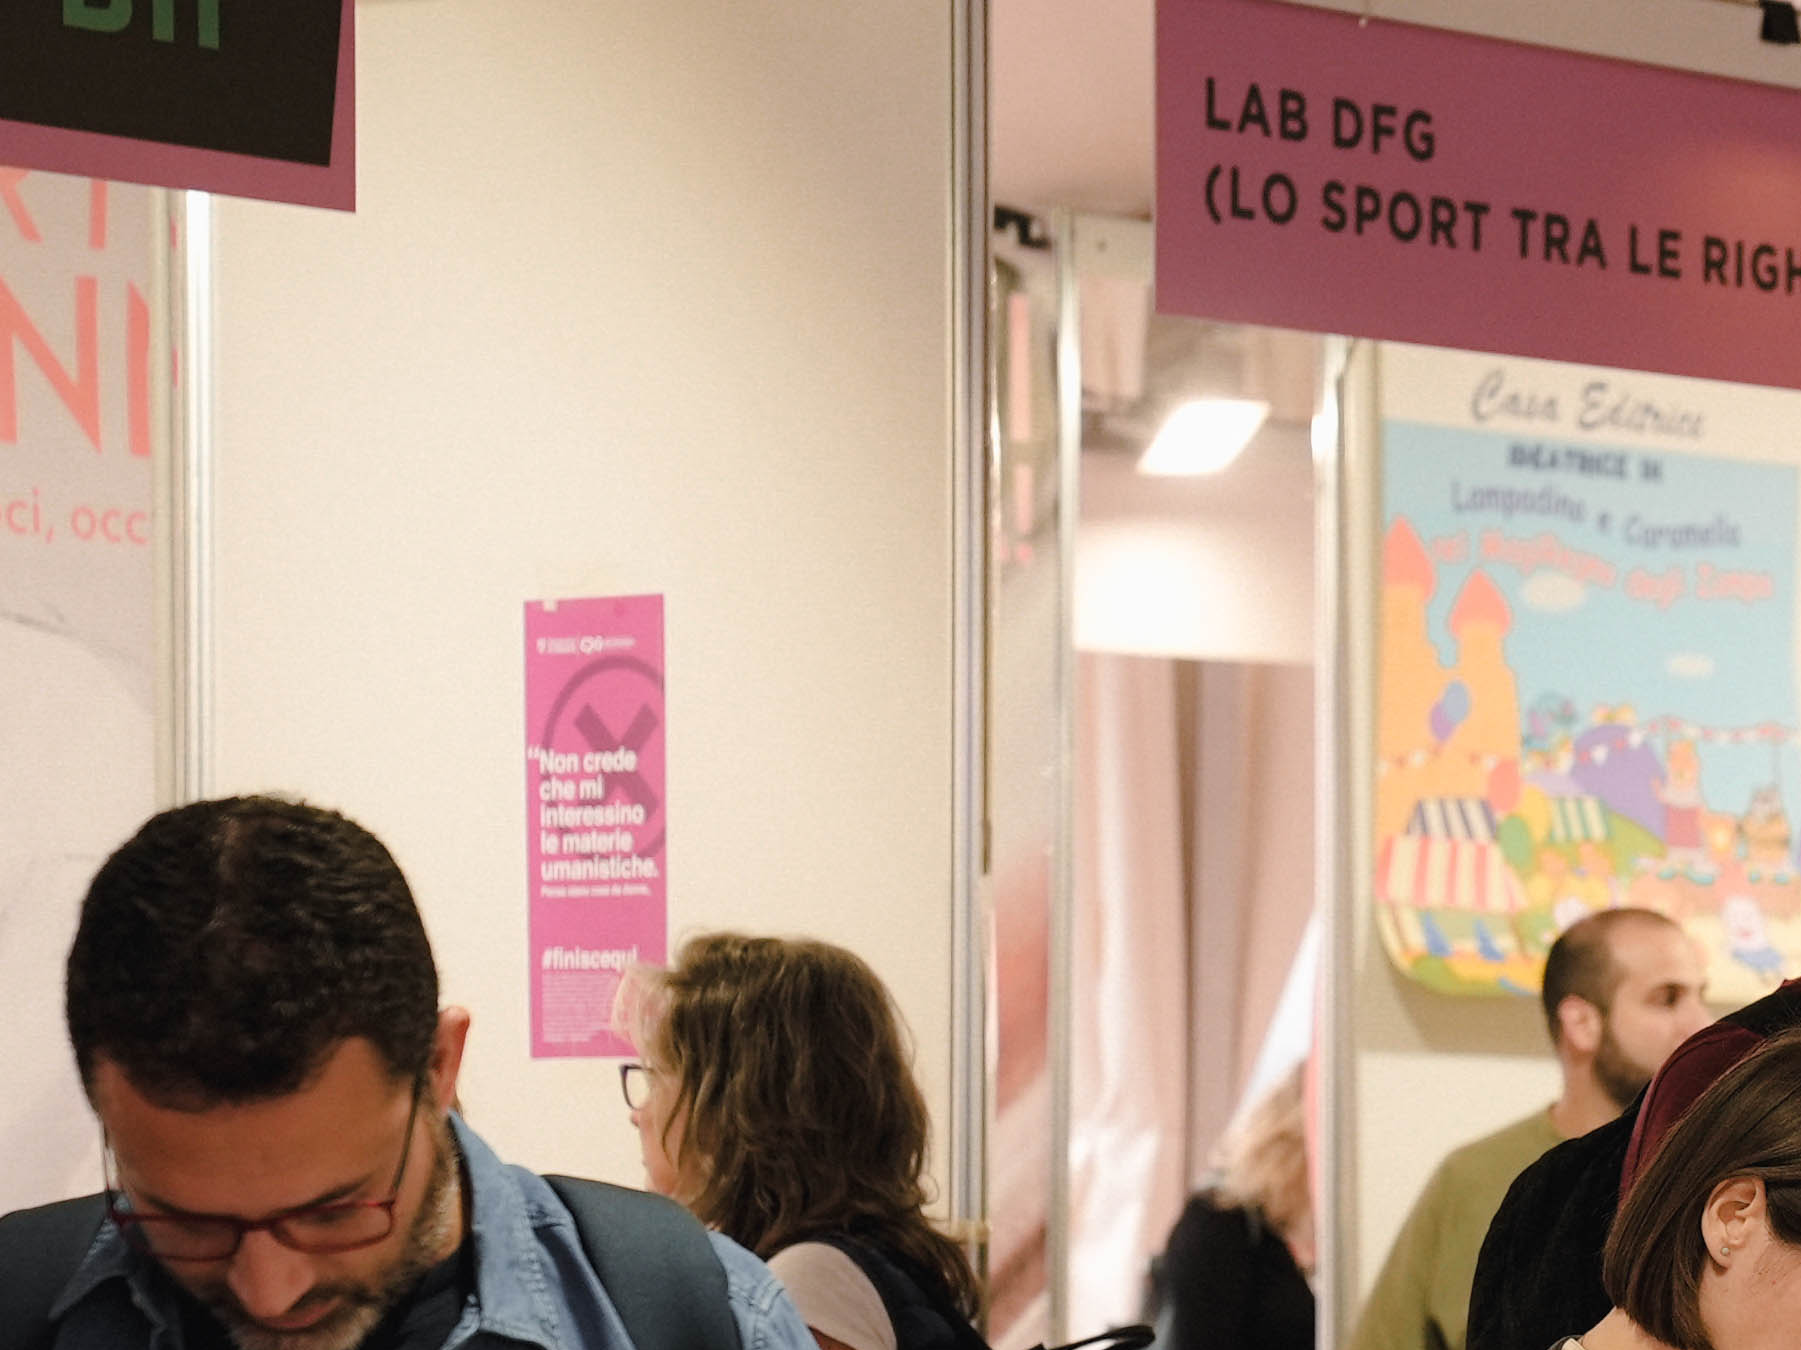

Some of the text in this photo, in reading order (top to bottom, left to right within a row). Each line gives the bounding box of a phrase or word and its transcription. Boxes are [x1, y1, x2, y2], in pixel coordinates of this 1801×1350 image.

[1203, 76, 1437, 163] LAB DFG
[1204, 163, 1299, 226] (LO
[1319, 180, 1491, 254] SPORT
[1511, 208, 1606, 271] TRA
[1628, 222, 1683, 281] LE
[1471, 368, 1560, 424] Casa
[582, 746, 638, 773] crede
[540, 773, 605, 801] che mi
[540, 801, 646, 828] interessino
[540, 828, 635, 855] le materie
